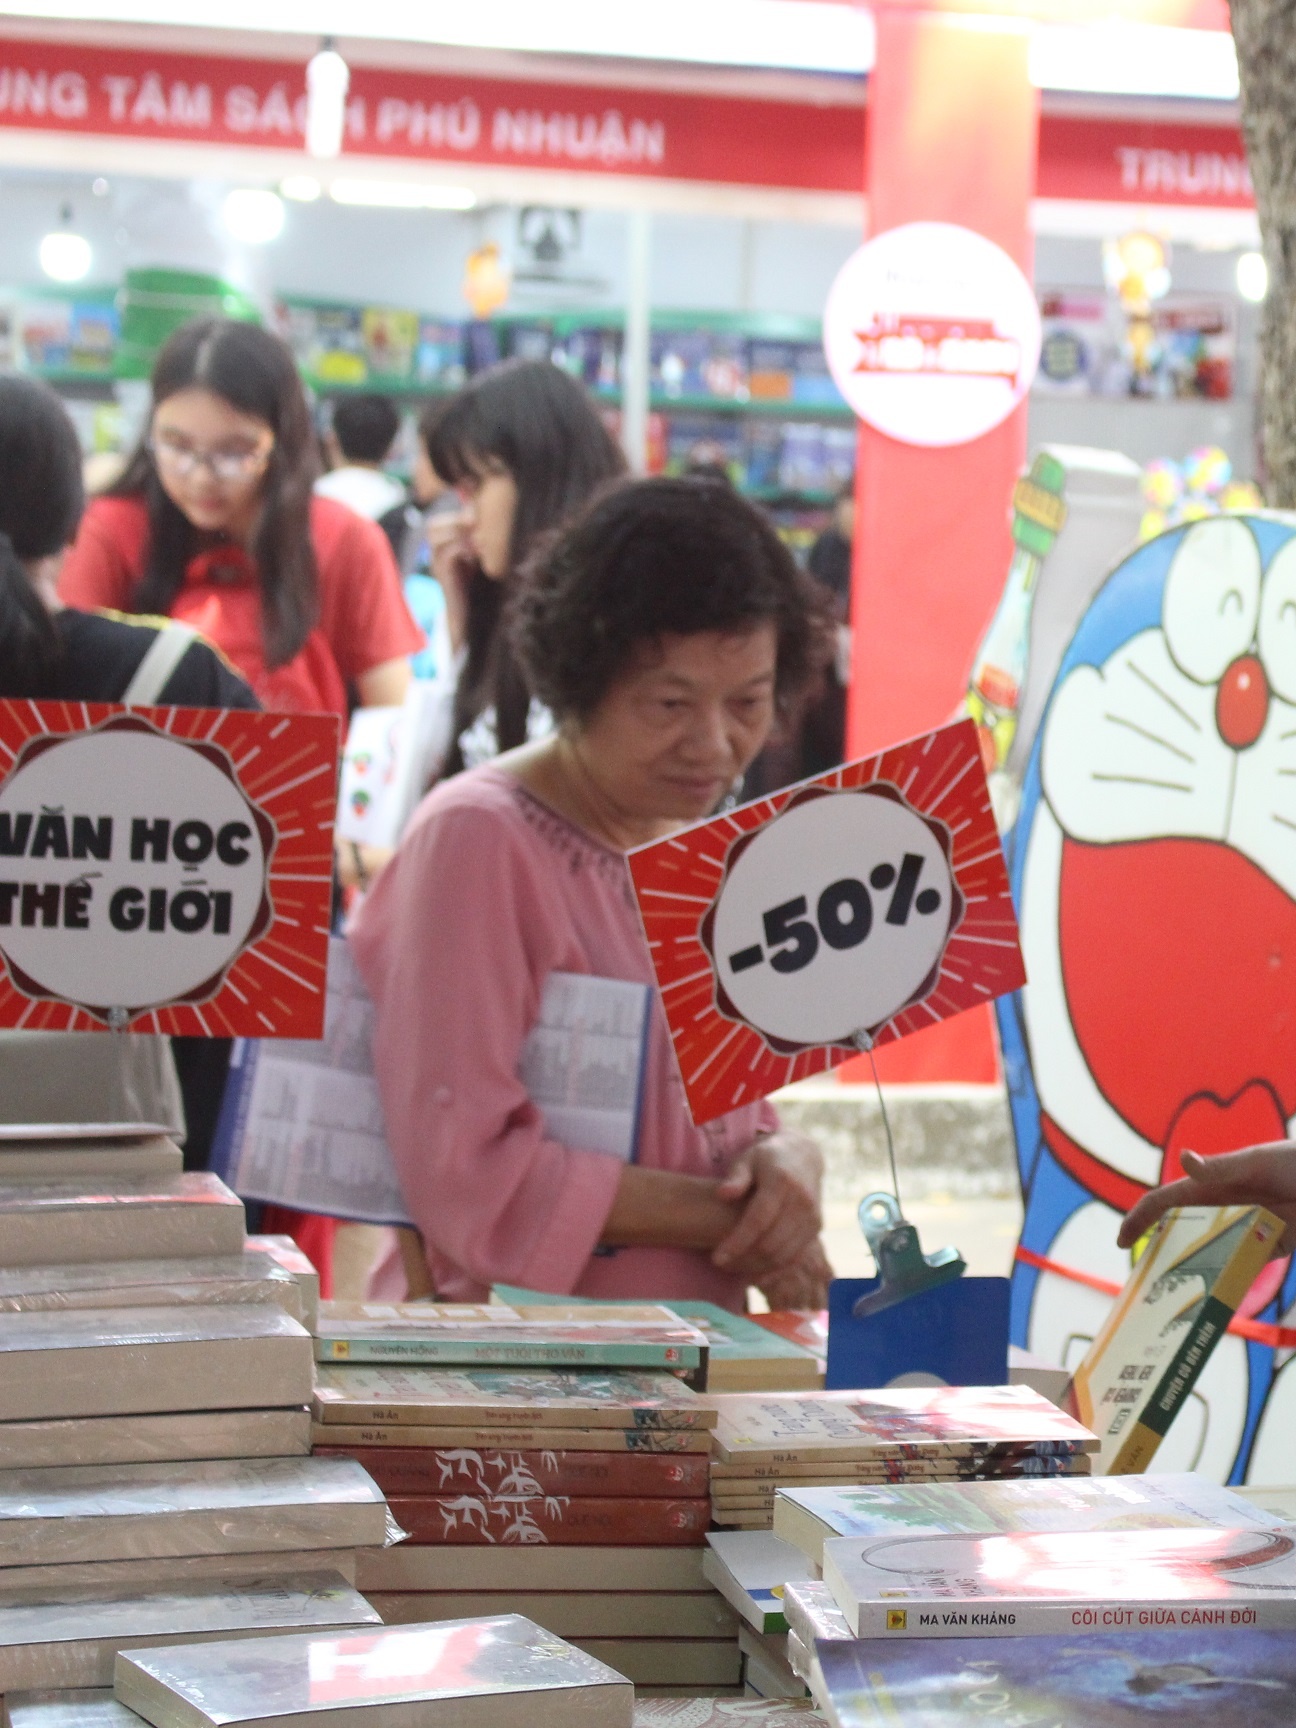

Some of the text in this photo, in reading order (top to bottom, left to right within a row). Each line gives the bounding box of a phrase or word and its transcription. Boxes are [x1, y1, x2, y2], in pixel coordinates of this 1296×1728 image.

[0, 804, 253, 872] VĂN HỌC
[109, 878, 233, 936] GIỚI
[729, 851, 942, 975] -50%
[919, 1614, 939, 1626] MA
[942, 1611, 968, 1625] VĂN
[1071, 1609, 1097, 1625] CÔI
[1102, 1607, 1134, 1625] CÚT
[1138, 1607, 1177, 1625] GIỮA
